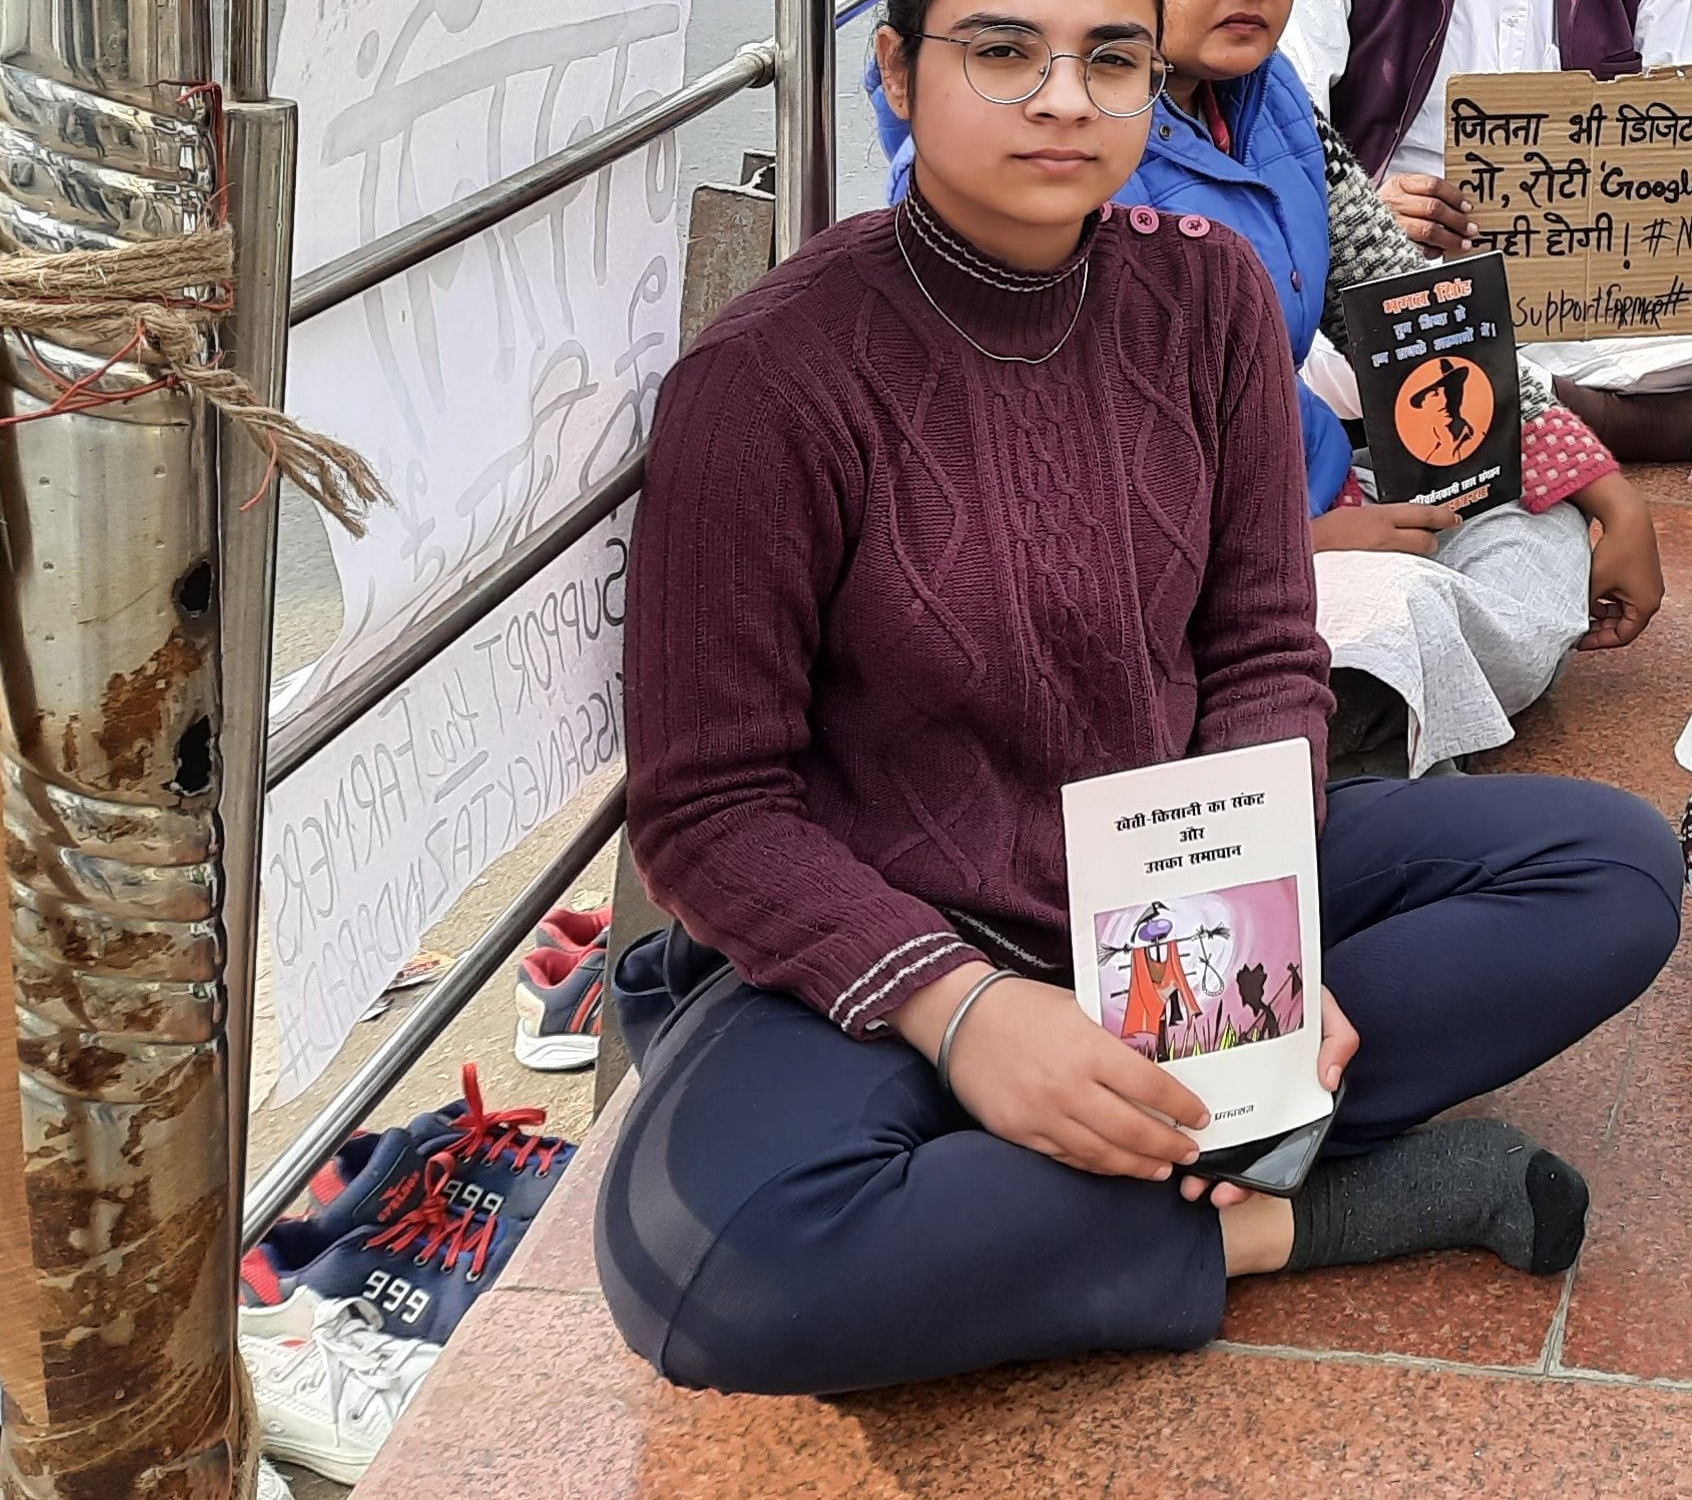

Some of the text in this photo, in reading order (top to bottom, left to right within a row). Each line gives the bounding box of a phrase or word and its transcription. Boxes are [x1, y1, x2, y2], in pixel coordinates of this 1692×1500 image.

[1450, 98, 1549, 147] जितना
[1567, 102, 1605, 148] भी
[1517, 151, 1591, 209] रोटी
[1206, 795, 1227, 815] का
[1230, 789, 1266, 811] संकट
[1178, 825, 1206, 845] और
[1143, 854, 1184, 876] उसका
[362, 1267, 432, 1326] 999
